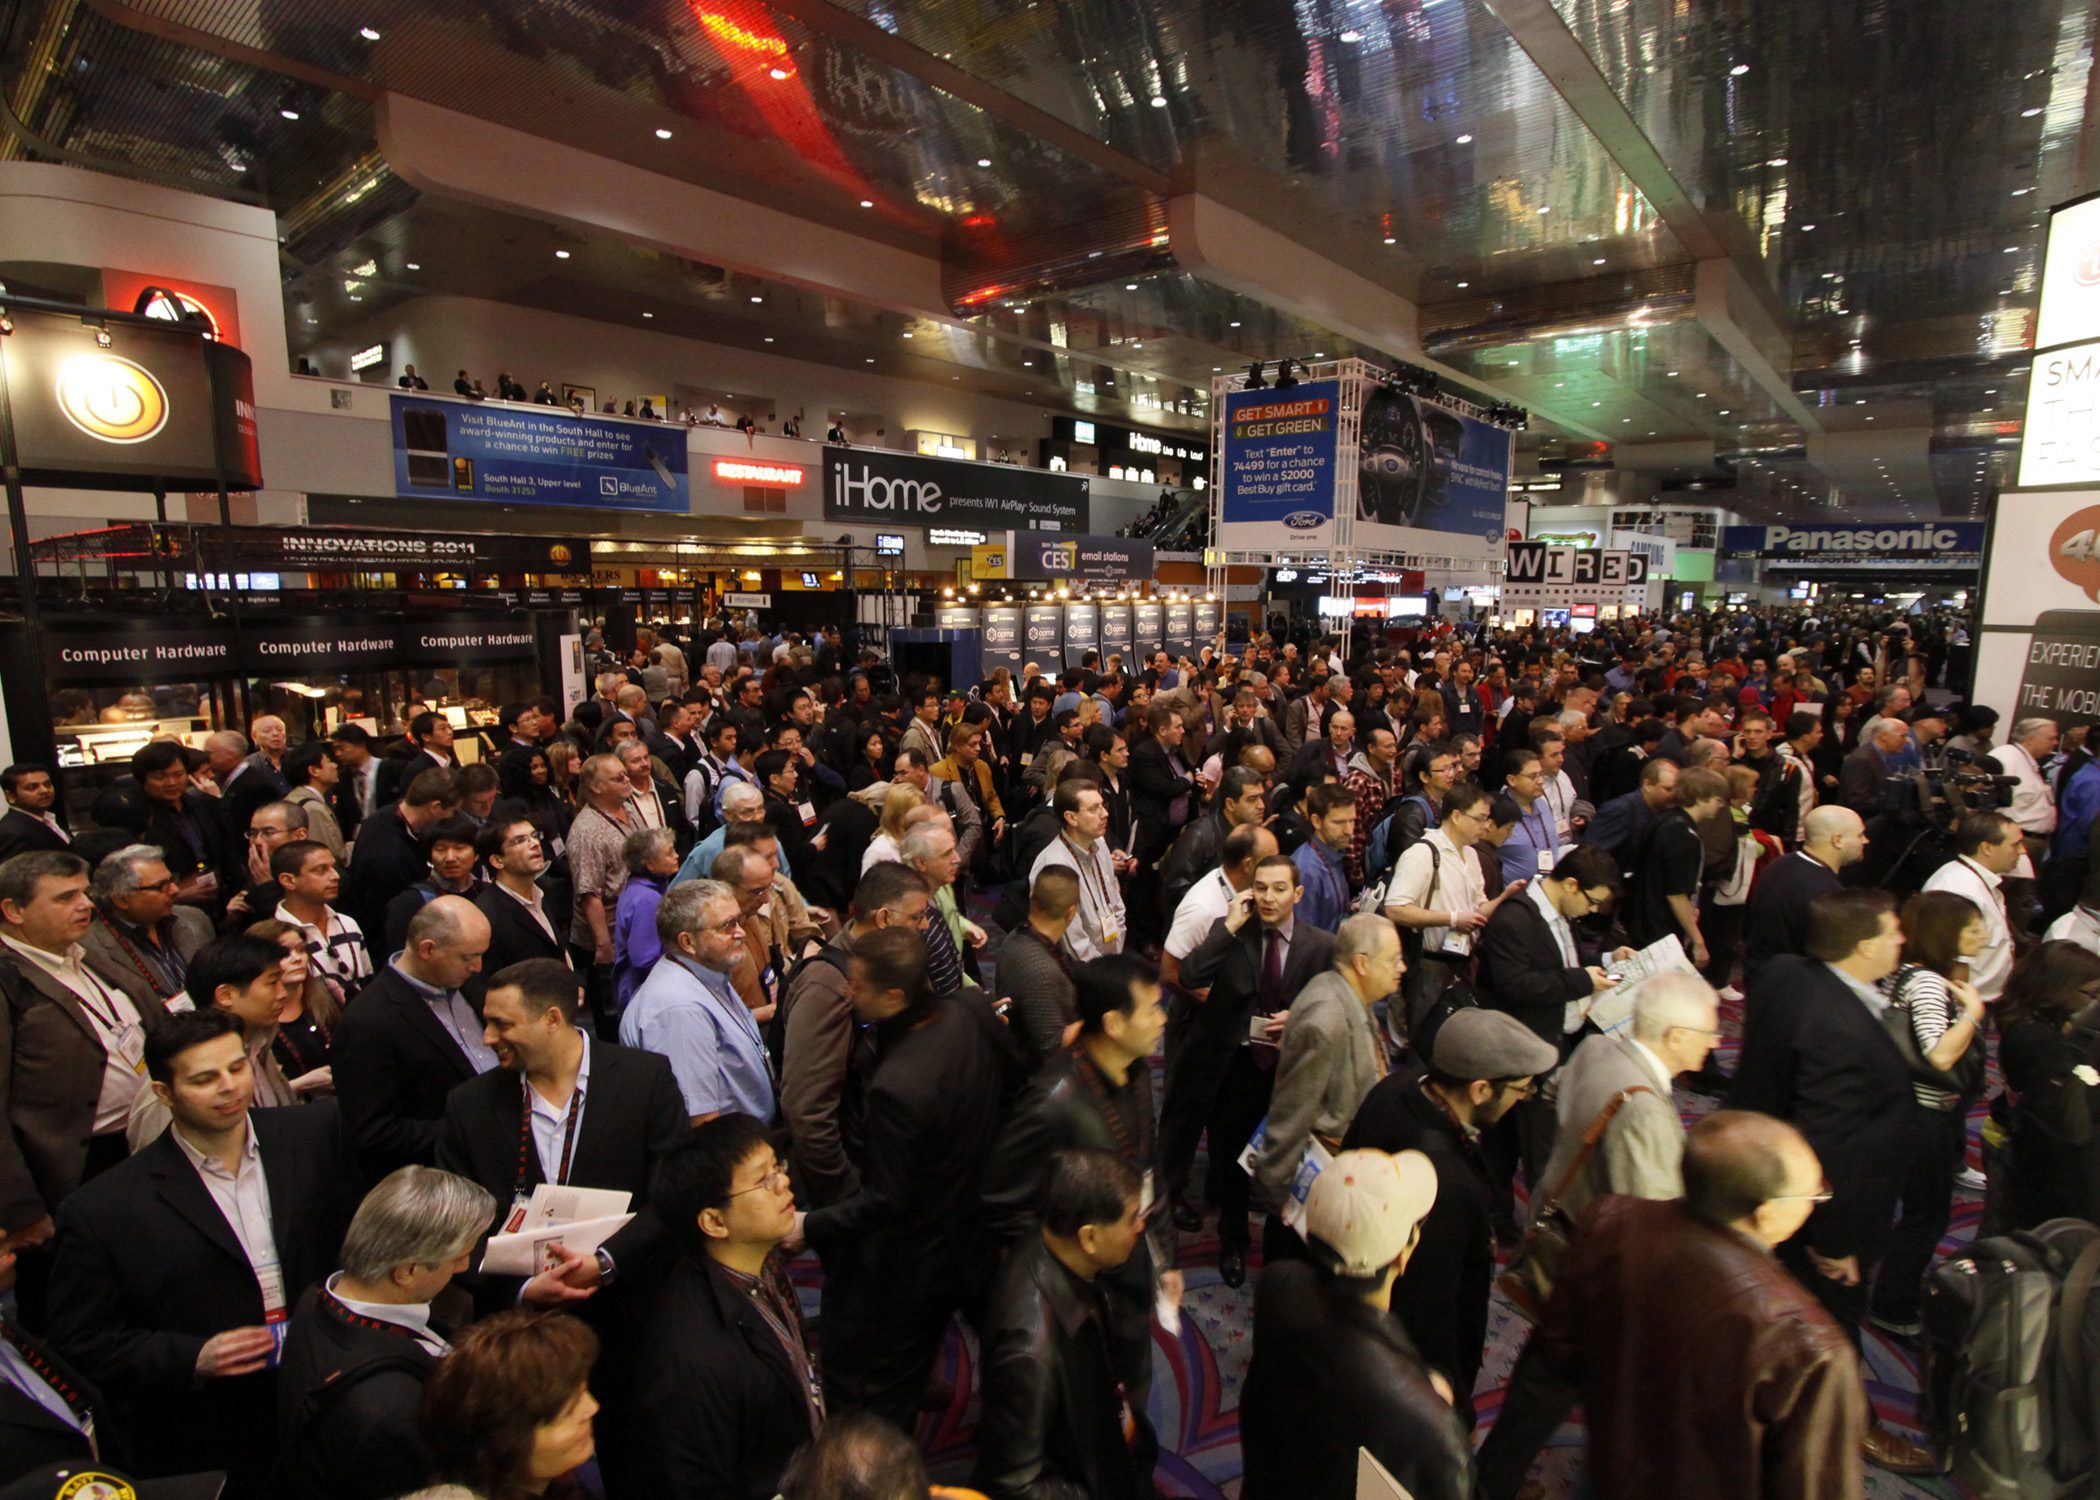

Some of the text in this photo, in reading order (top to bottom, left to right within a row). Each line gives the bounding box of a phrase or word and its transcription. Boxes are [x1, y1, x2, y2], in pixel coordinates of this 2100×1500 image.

[1236, 401, 1313, 421] GET SMART
[461, 413, 631, 442] Visit BlueAnt in the South Hall to see
[1247, 418, 1322, 437] GET GREEN
[459, 426, 633, 451] award-winning products and enter for
[1129, 431, 1162, 454] iHome
[494, 440, 528, 452] chance
[530, 443, 540, 453] to
[542, 446, 558, 455] win
[560, 447, 585, 457] FREE
[587, 450, 614, 461] prizes
[1244, 450, 1264, 459] Text
[1303, 445, 1314, 455] to
[1233, 456, 1325, 471] 74499 for a chance
[483, 472, 582, 489] South Hall 3, Upper level
[717, 462, 802, 484] RESTAURANT
[1243, 473, 1253, 482] to
[1254, 472, 1271, 481] win
[1280, 469, 1315, 481] $2000
[484, 484, 537, 496] Booth 31253
[619, 481, 658, 494] BlueAnt
[834, 462, 943, 513] iHome
[1237, 485, 1257, 495] Best
[1257, 484, 1274, 495] Buy
[1276, 482, 1292, 495] gift
[949, 497, 984, 508] presents
[1029, 502, 1052, 513] Sound
[1052, 503, 1076, 516] System
[1291, 513, 1317, 526] Ford
[282, 537, 476, 554] INNOVATIONS 2011
[1764, 523, 1958, 551] Panasonic
[2061, 529, 2100, 562] 4
[989, 556, 1002, 566] CES
[1042, 551, 1069, 569] CES
[1081, 551, 1129, 562] email stations
[1508, 547, 1643, 580] WIRED
[420, 632, 533, 649] Computer Hardware
[996, 630, 1015, 638] ooma
[1038, 629, 1055, 637] ooma
[61, 643, 227, 664] Computer Hardware
[259, 637, 395, 657] Computer Hardware
[2022, 683, 2100, 717] THE MOBI
